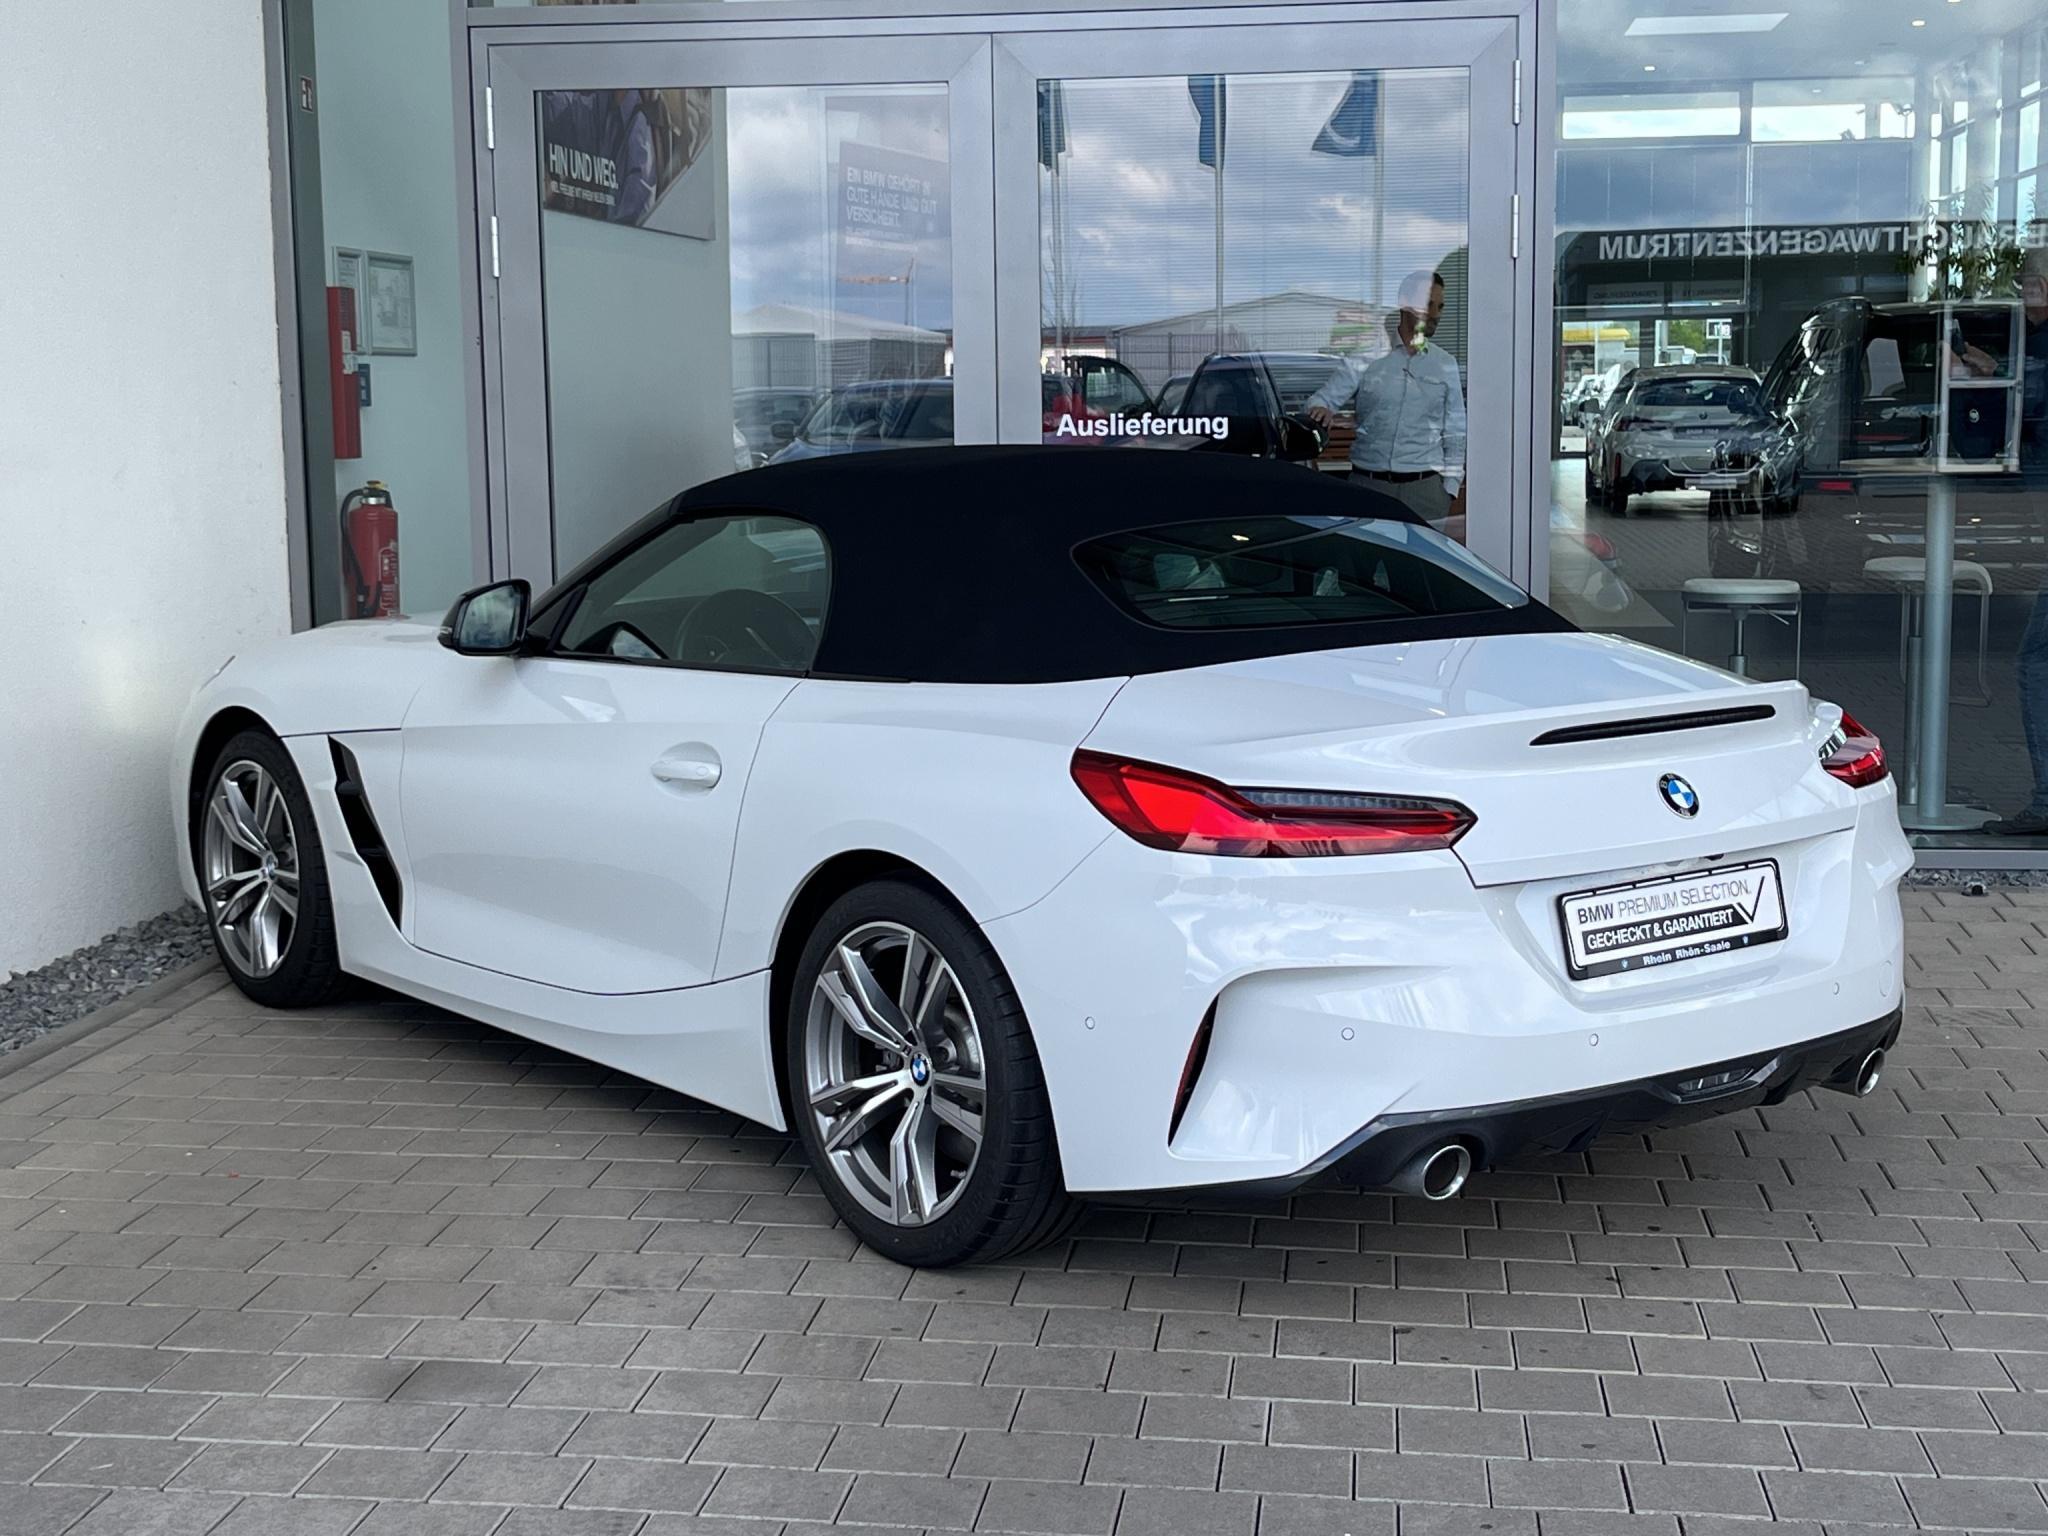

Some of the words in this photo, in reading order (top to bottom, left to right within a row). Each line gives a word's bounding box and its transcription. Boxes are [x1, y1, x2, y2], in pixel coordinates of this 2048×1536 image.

[549, 143, 568, 177] HIN
[569, 148, 592, 182] UND
[593, 155, 619, 190] WEG.
[863, 169, 886, 188] BMW
[847, 186, 869, 204] GUTE
[1056, 413, 1229, 440] Auslieferung
[1577, 902, 1614, 924] BMW
[1618, 891, 1679, 919] PREMIUM
[1586, 924, 1652, 950] GECHECKT
[1653, 922, 1663, 937] &
[1663, 908, 1734, 936] GARANTIERT
[1643, 952, 1672, 966] Rhein
[1675, 939, 1731, 960] Rhön-Saale
